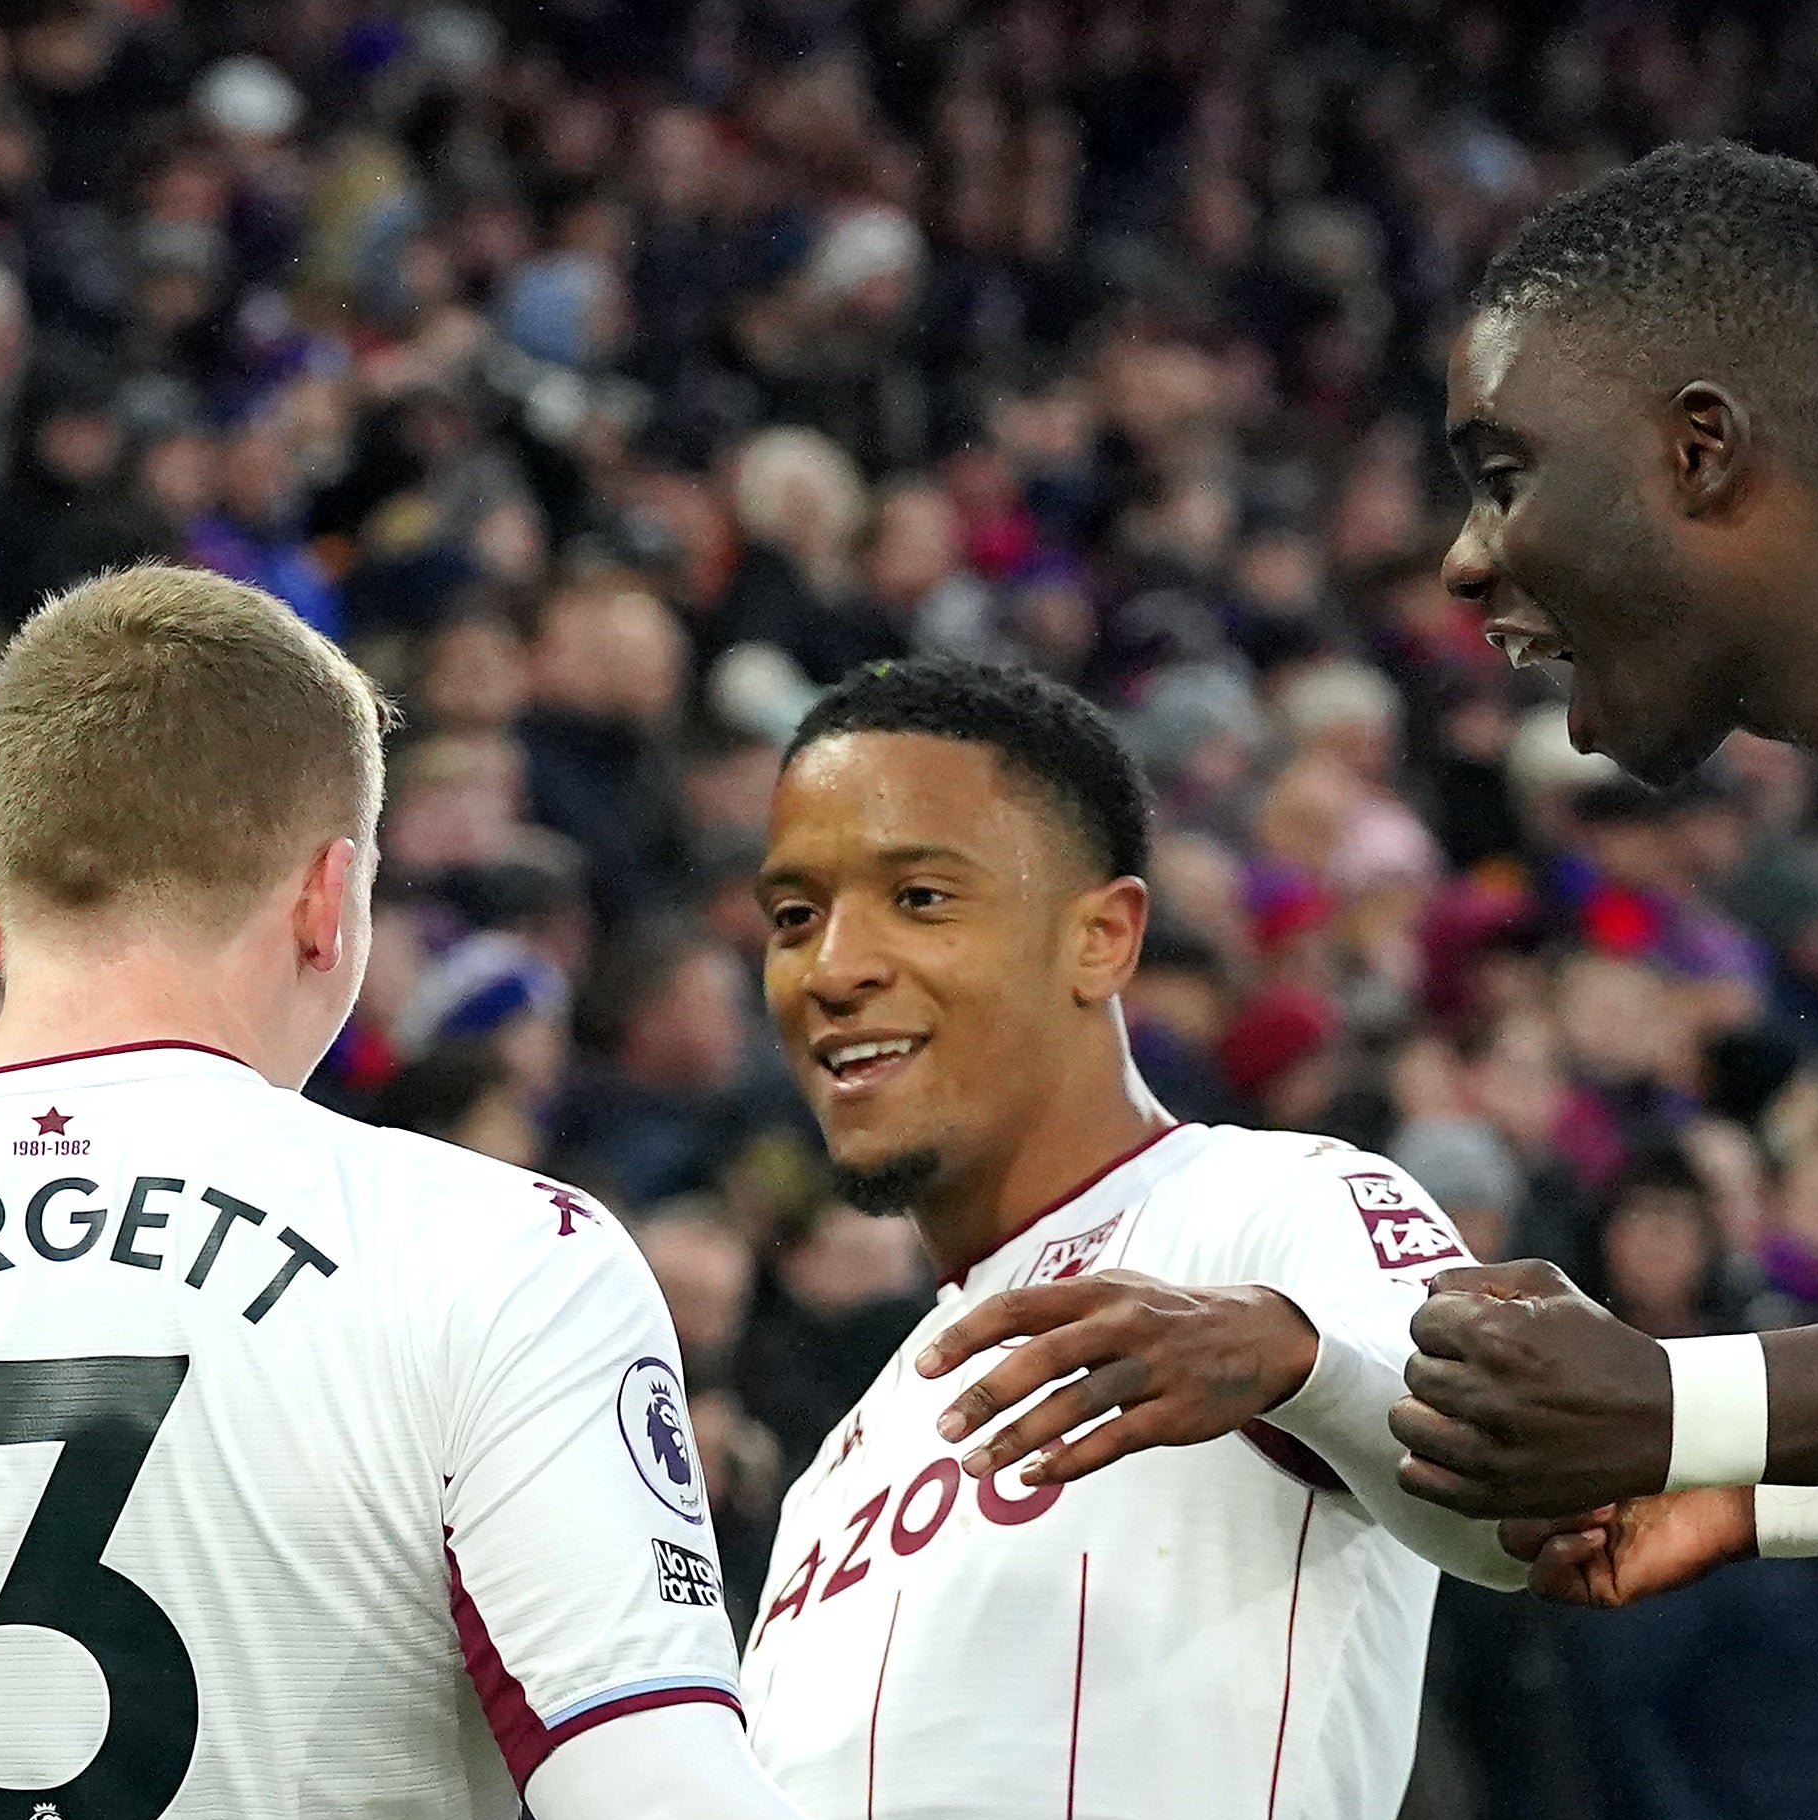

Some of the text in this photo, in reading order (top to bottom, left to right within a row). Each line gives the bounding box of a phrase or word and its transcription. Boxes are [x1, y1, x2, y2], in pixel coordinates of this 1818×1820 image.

[12, 1139, 91, 1157] 1981-1982
[1371, 1217, 1454, 1263] 体
[752, 1437, 1066, 1651] AZOO
